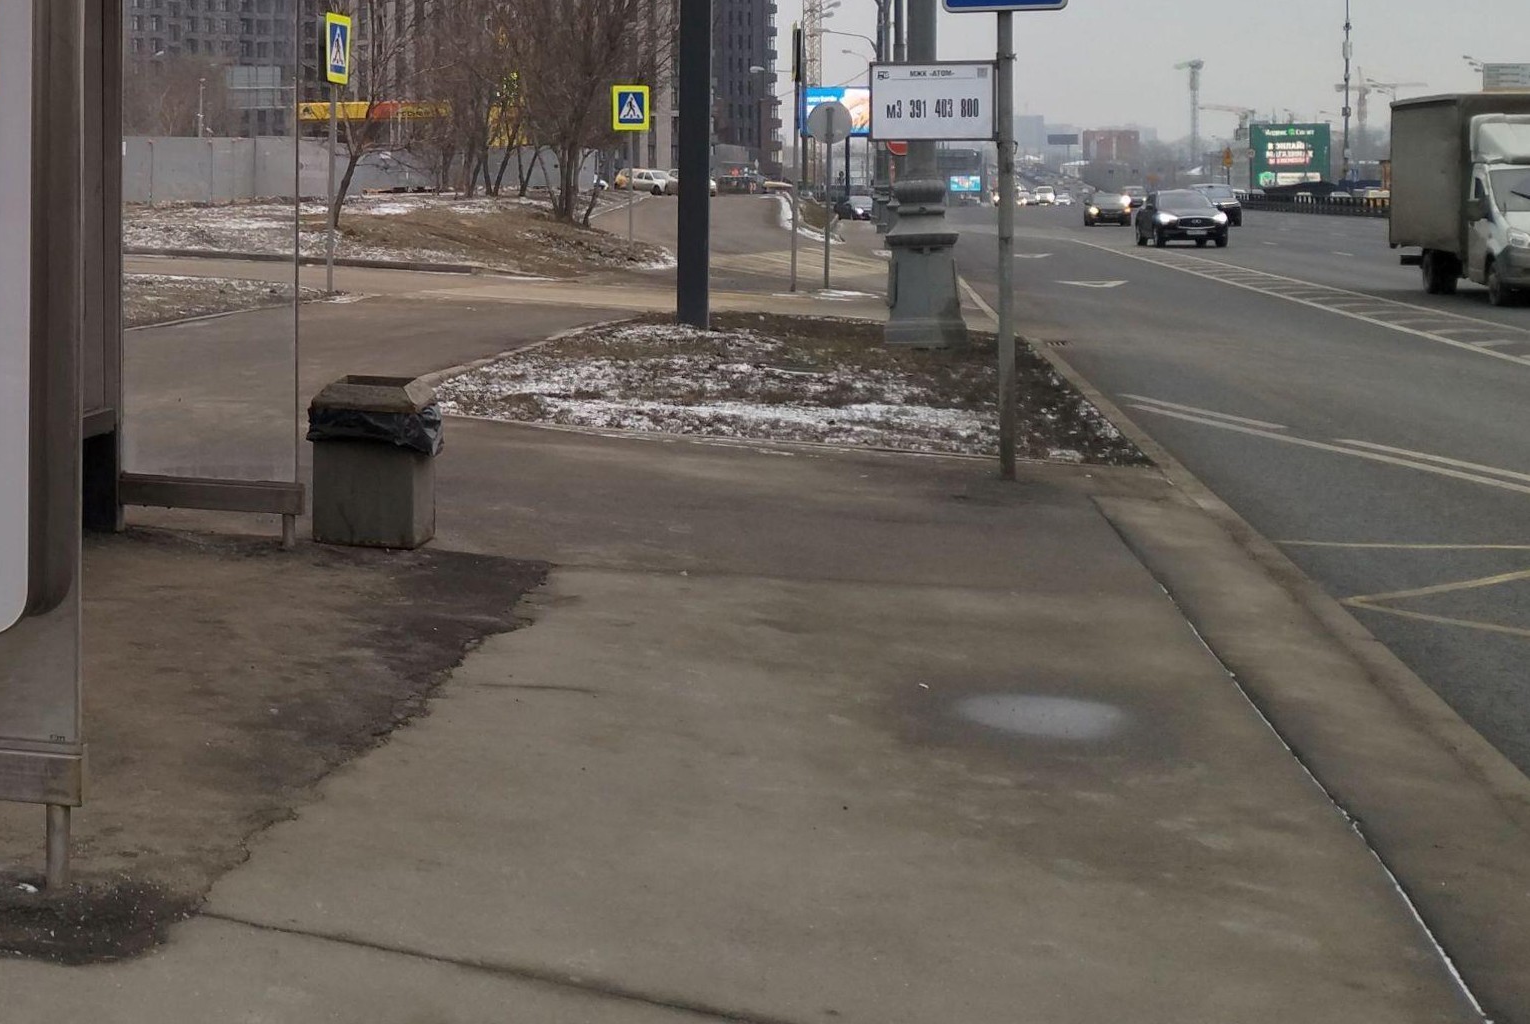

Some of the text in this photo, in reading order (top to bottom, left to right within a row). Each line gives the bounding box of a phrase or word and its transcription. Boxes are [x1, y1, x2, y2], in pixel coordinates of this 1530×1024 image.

[909, 99, 926, 118] 391
[935, 99, 953, 117] 403
[960, 98, 979, 117] 800
